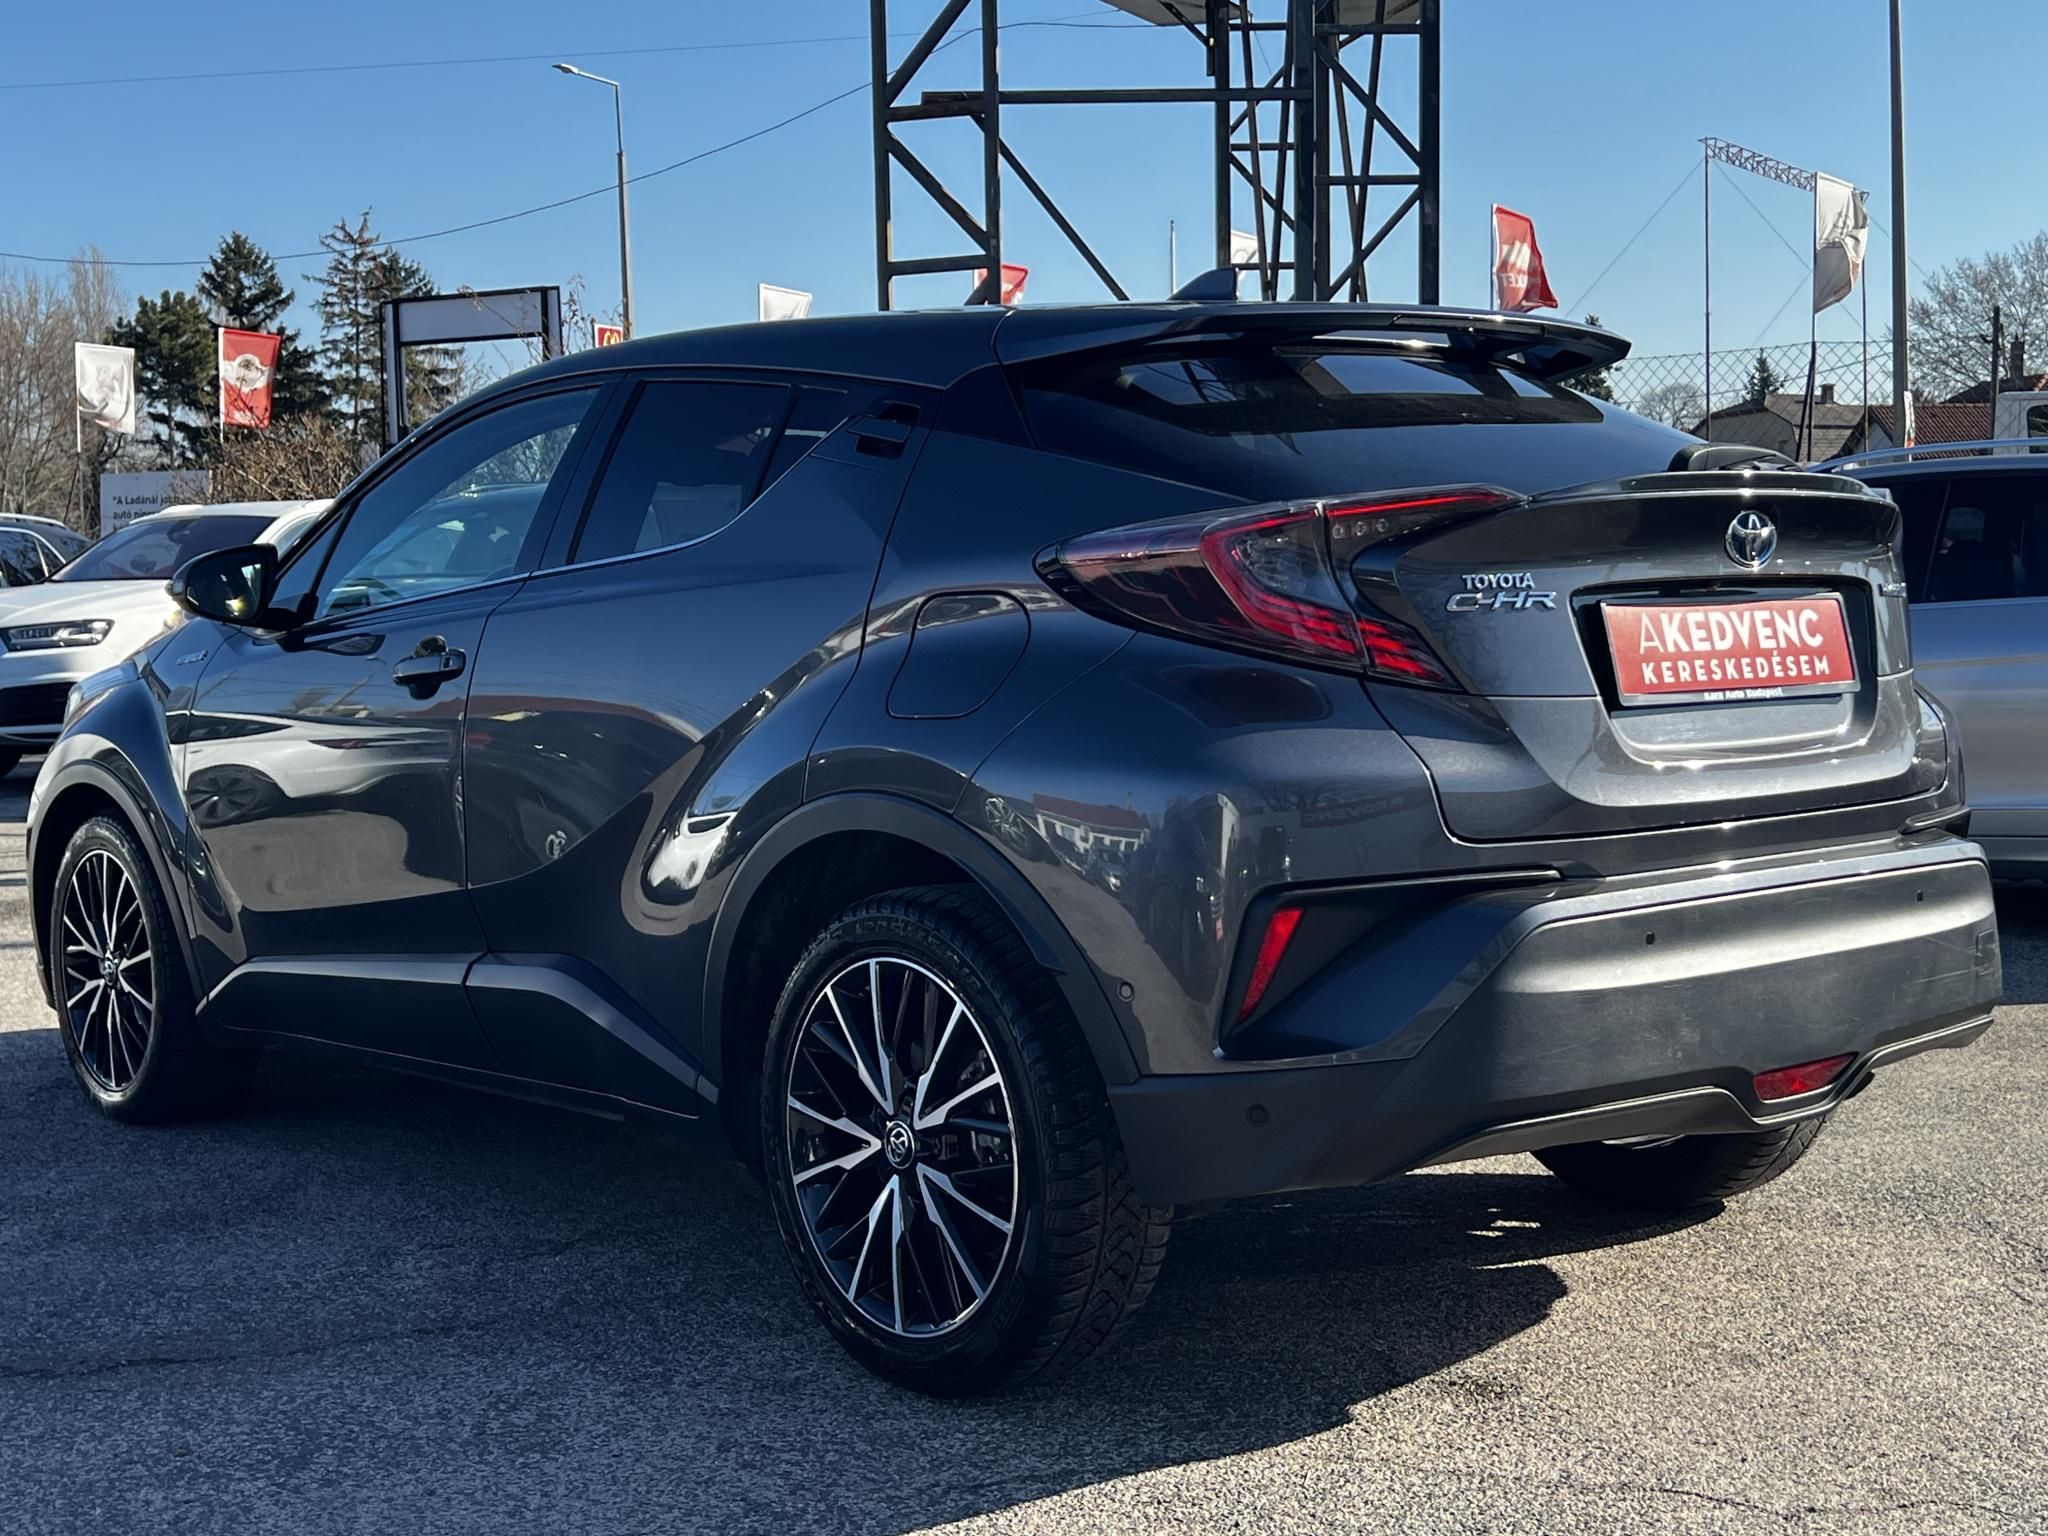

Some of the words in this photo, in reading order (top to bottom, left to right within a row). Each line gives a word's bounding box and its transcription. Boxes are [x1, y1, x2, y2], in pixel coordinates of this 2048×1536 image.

[113, 508, 132, 520] autó
[1462, 572, 1536, 590] TOYOTA
[1446, 591, 1557, 612] C-HR
[1641, 650, 1830, 685] KERESKEDÉSEM
